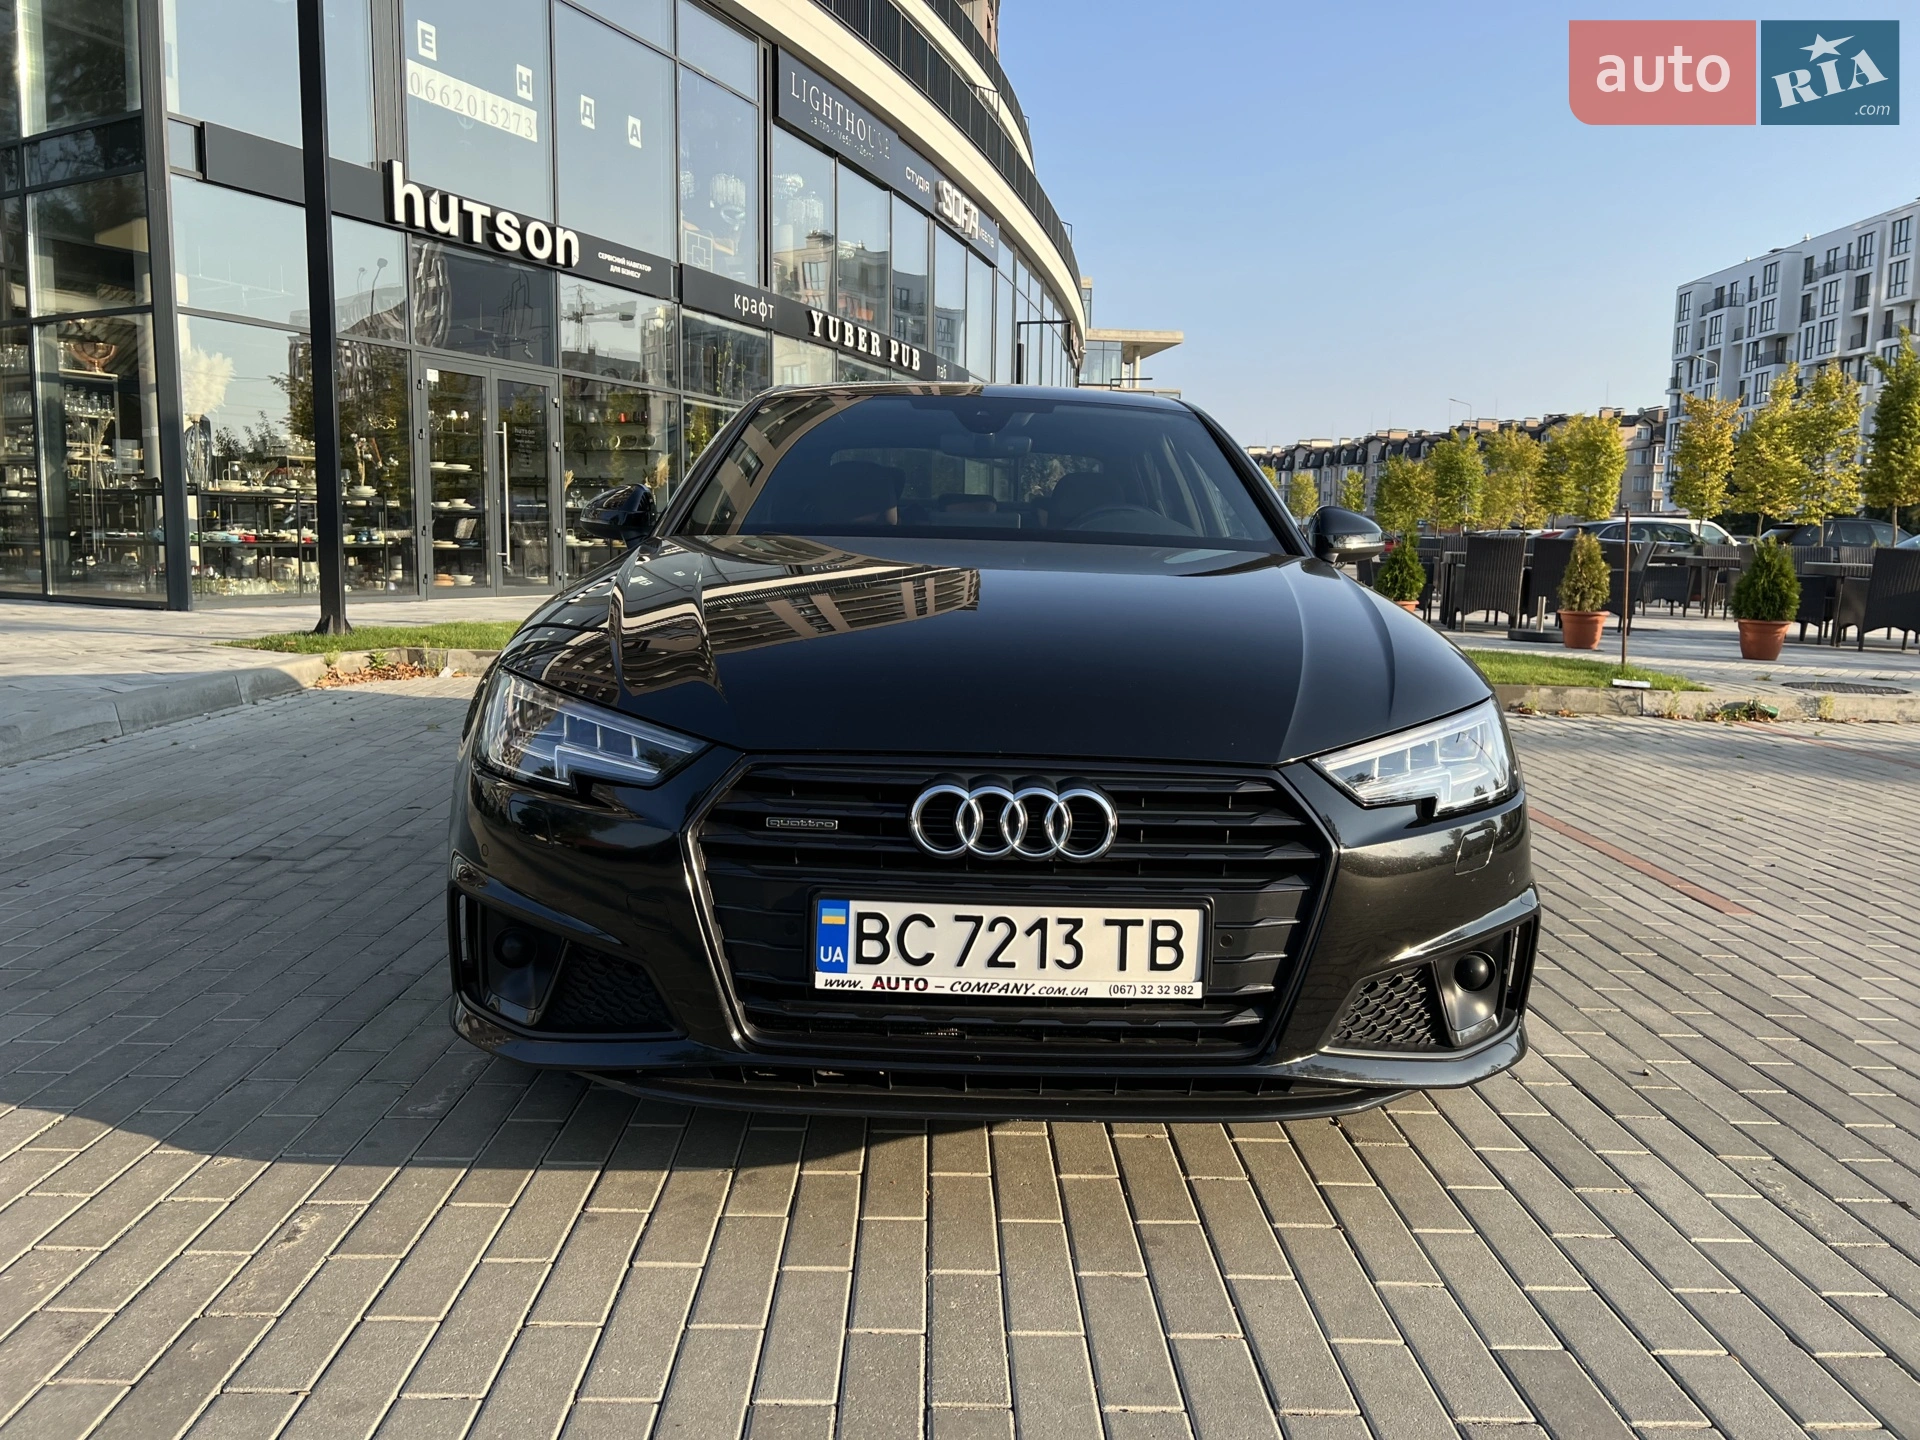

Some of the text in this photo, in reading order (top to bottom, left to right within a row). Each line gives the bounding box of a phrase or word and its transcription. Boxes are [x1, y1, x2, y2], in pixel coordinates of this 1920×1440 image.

[409, 71, 534, 138] 0662015273
[791, 71, 891, 160] LIGHTHOUSE
[940, 180, 979, 241] SOFA
[734, 293, 775, 322] крафт
[810, 309, 921, 372] YUBER PUB
[768, 818, 835, 828] quattro
[820, 945, 845, 964] UA
[855, 911, 1185, 972] BC 7213 TB
[872, 976, 929, 991] AUTO
[1108, 984, 1138, 996] (067)
[1140, 985, 1154, 995] 32
[1156, 985, 1171, 996] 32
[1173, 985, 1194, 996] 982
